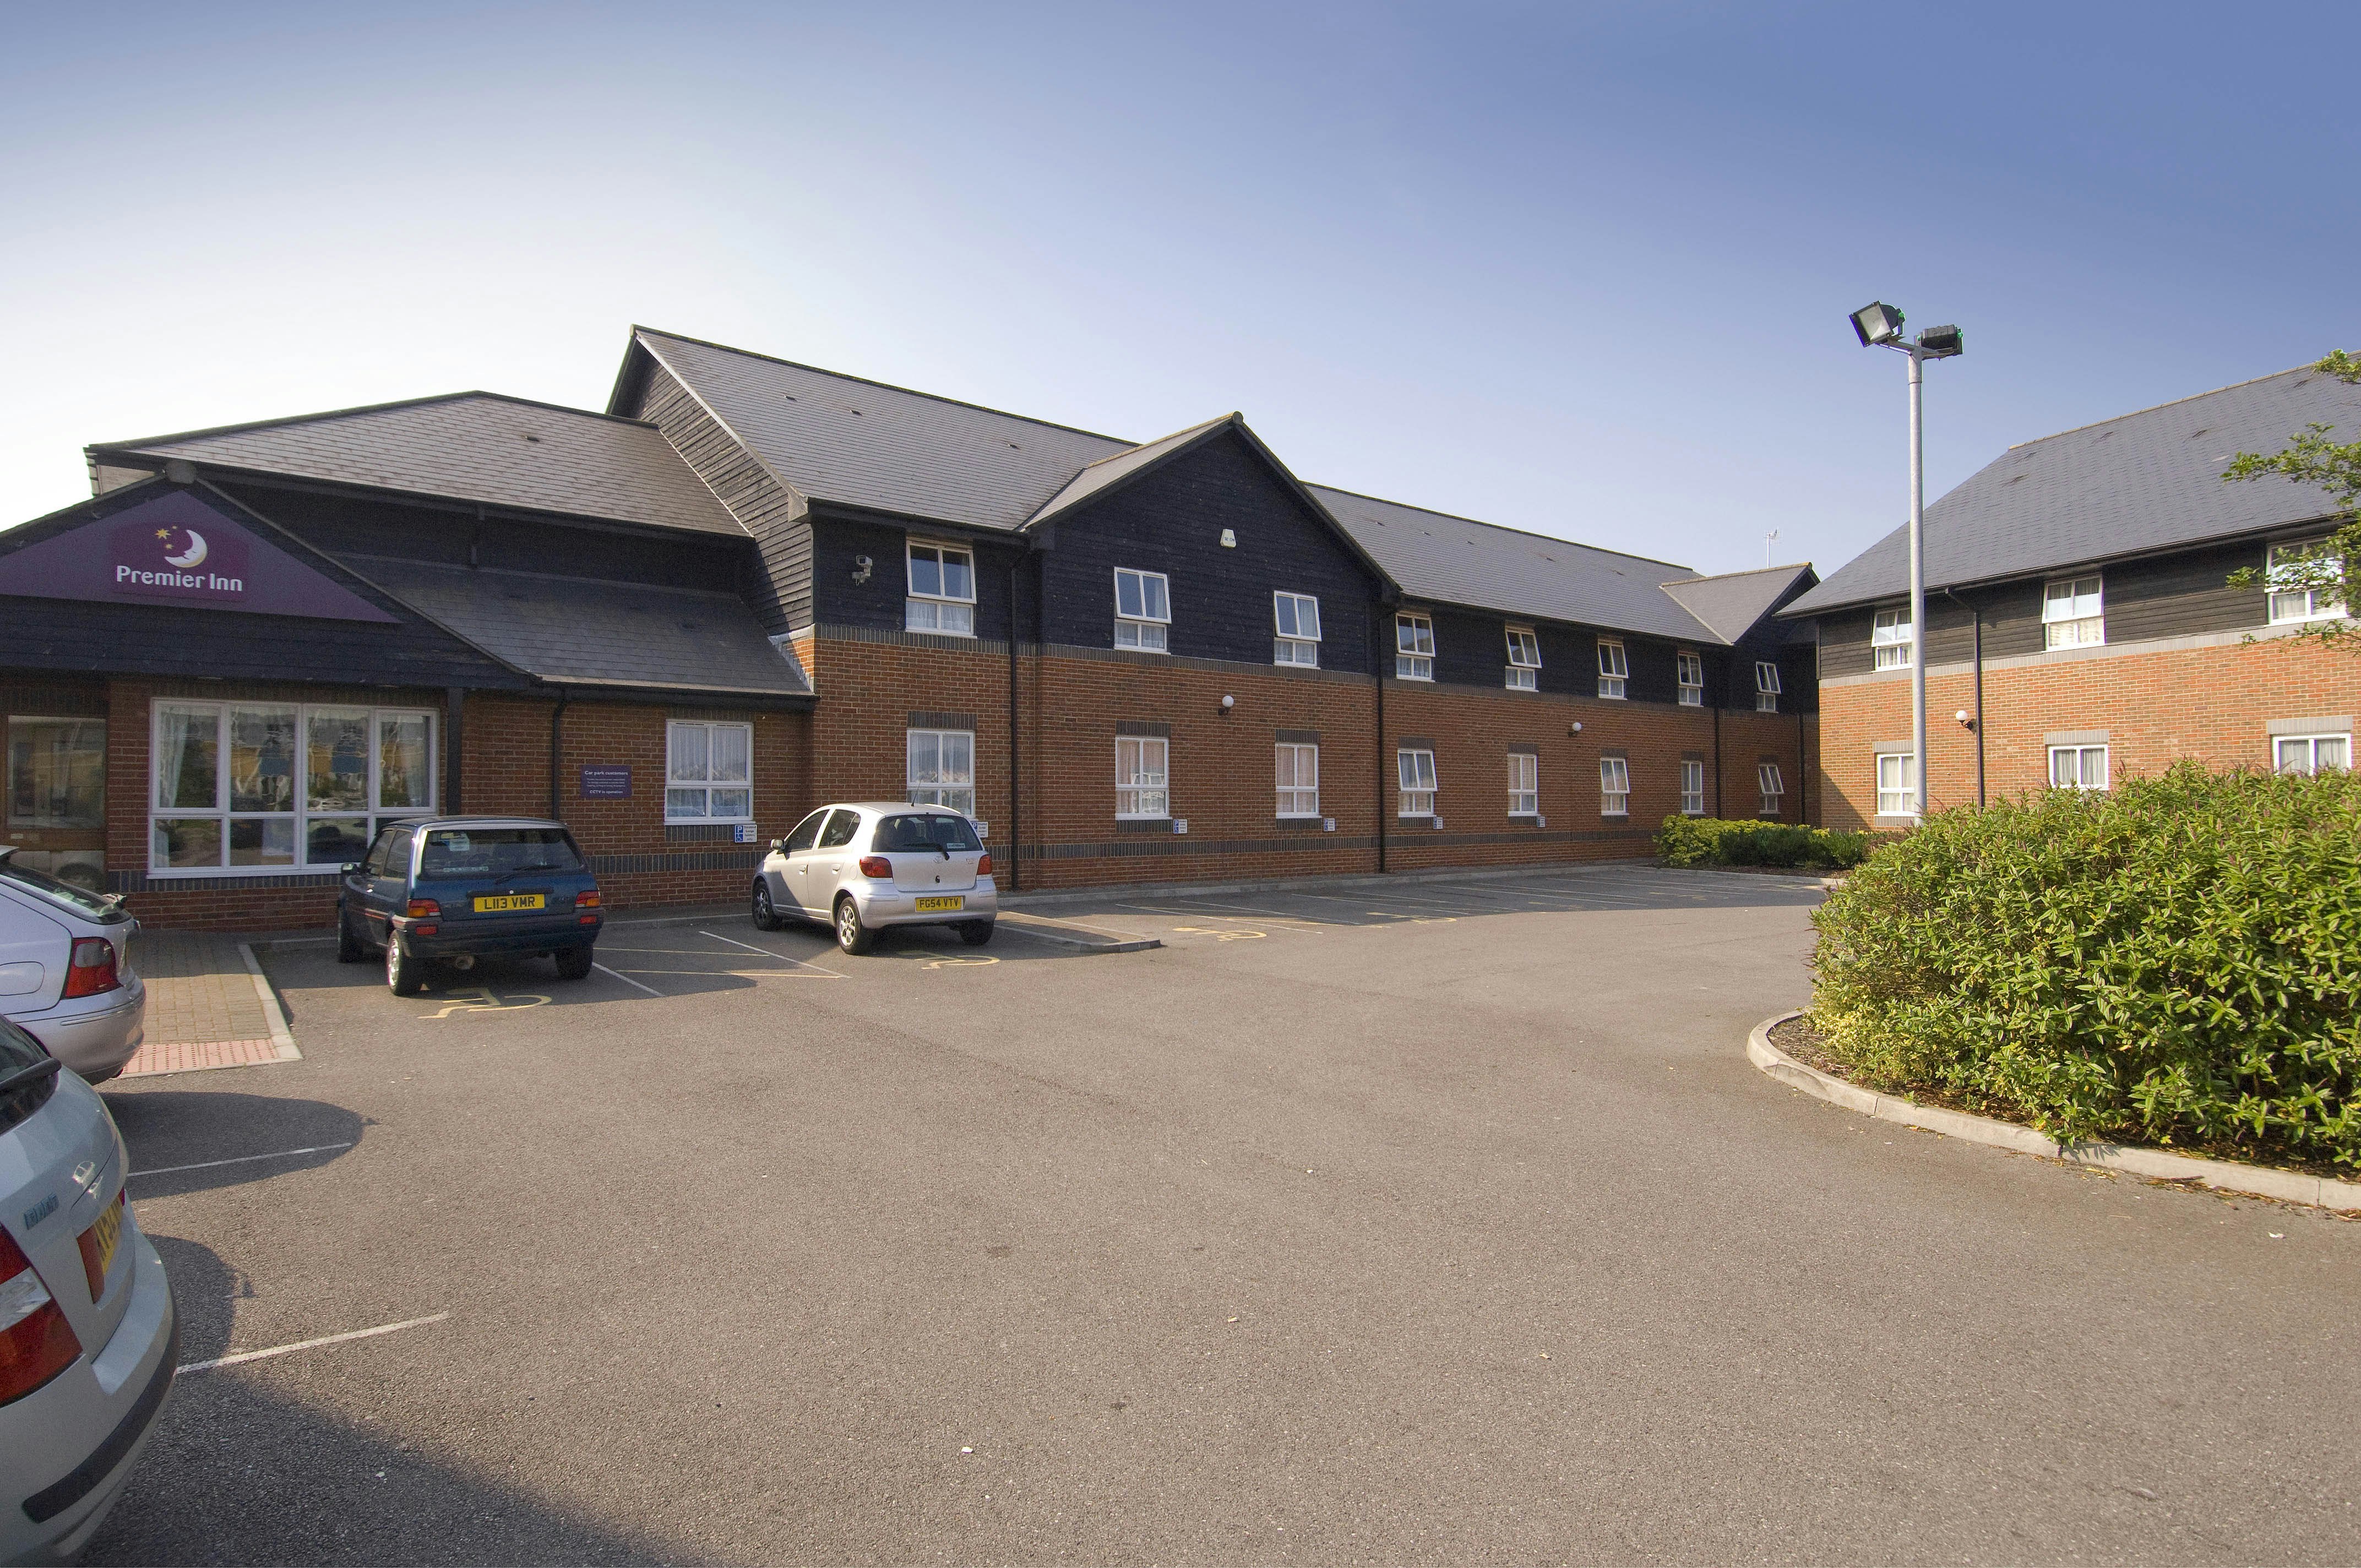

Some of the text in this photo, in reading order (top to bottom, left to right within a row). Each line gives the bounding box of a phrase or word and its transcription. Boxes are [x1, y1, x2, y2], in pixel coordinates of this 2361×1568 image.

[117, 565, 243, 591] Premier Inn
[484, 896, 535, 910] L113 VMR
[920, 898, 959, 908] FG54 VTV
